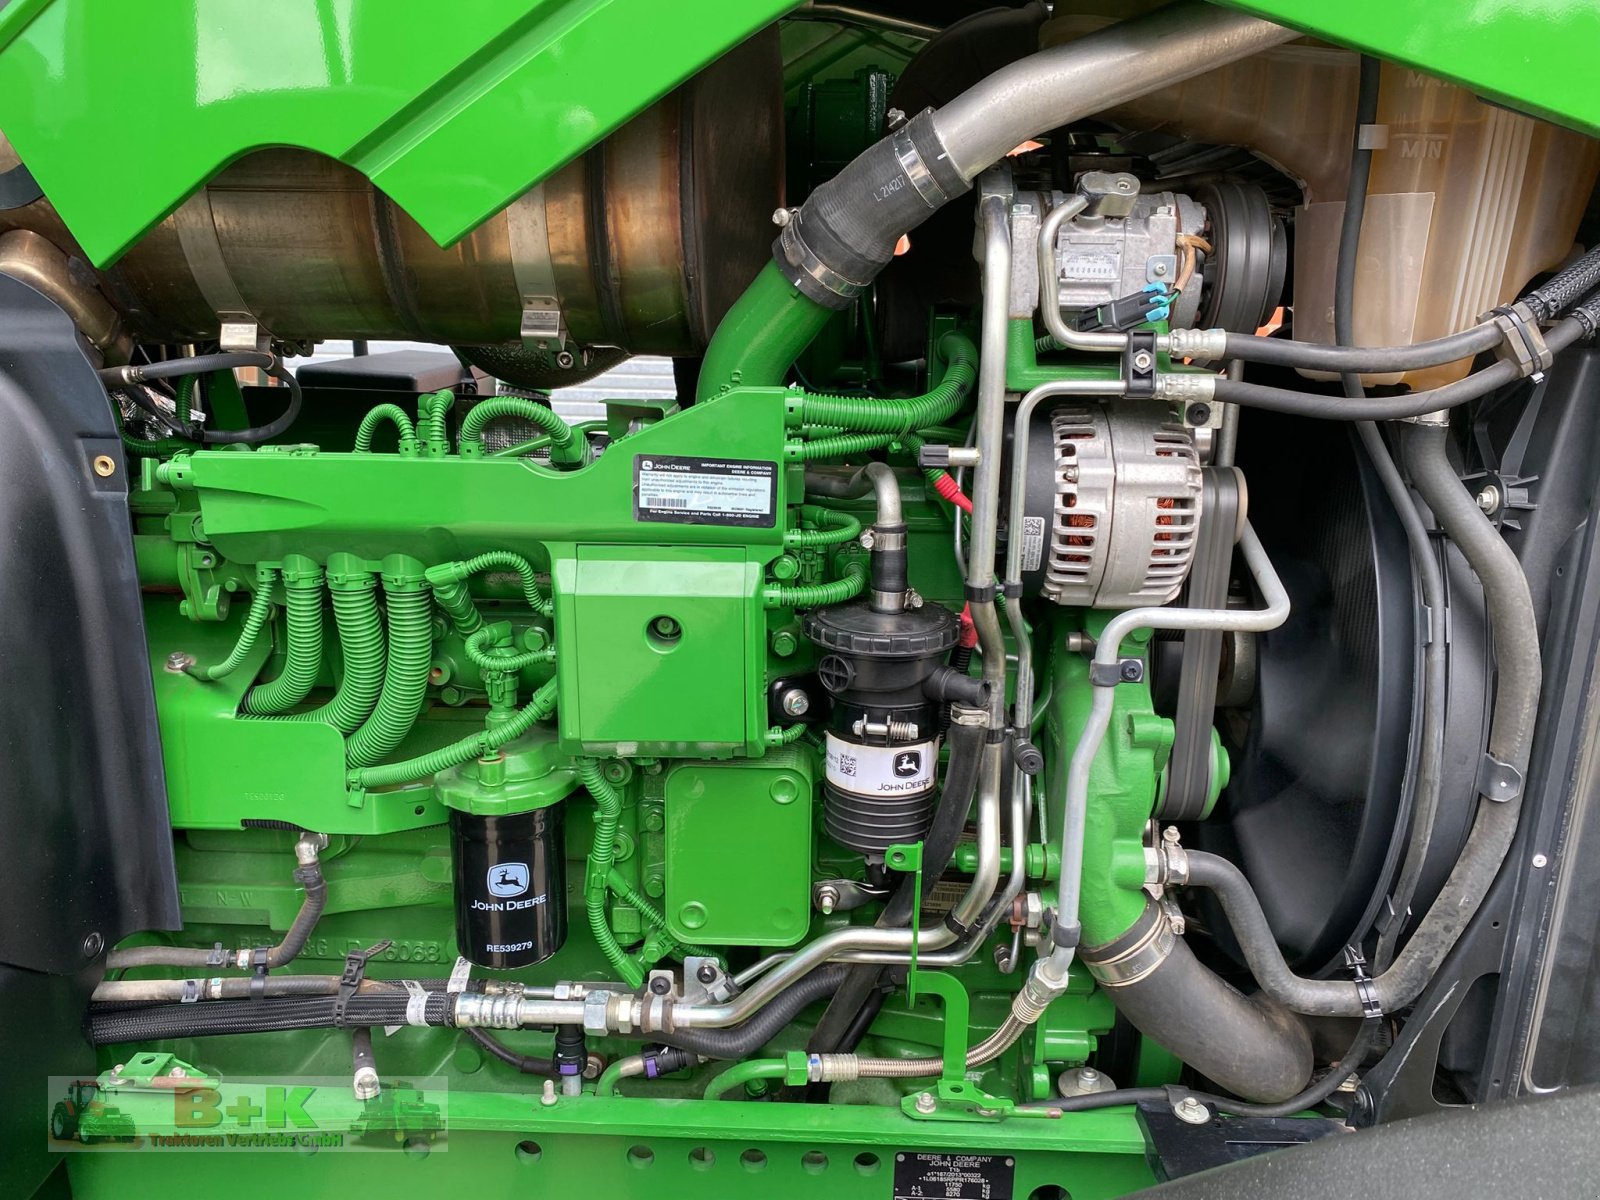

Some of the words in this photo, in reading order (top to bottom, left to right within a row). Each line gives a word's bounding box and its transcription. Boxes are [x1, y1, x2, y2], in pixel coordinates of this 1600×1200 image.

[1402, 140, 1442, 158] MIN
[873, 192, 882, 202] L
[880, 174, 905, 198] 214217
[877, 782, 904, 791] JOHN
[905, 776, 930, 790] DEERE
[471, 900, 504, 911] JOHN
[506, 894, 546, 911] DEERE
[384, 940, 440, 962] 6068
[486, 941, 533, 953] RE539279
